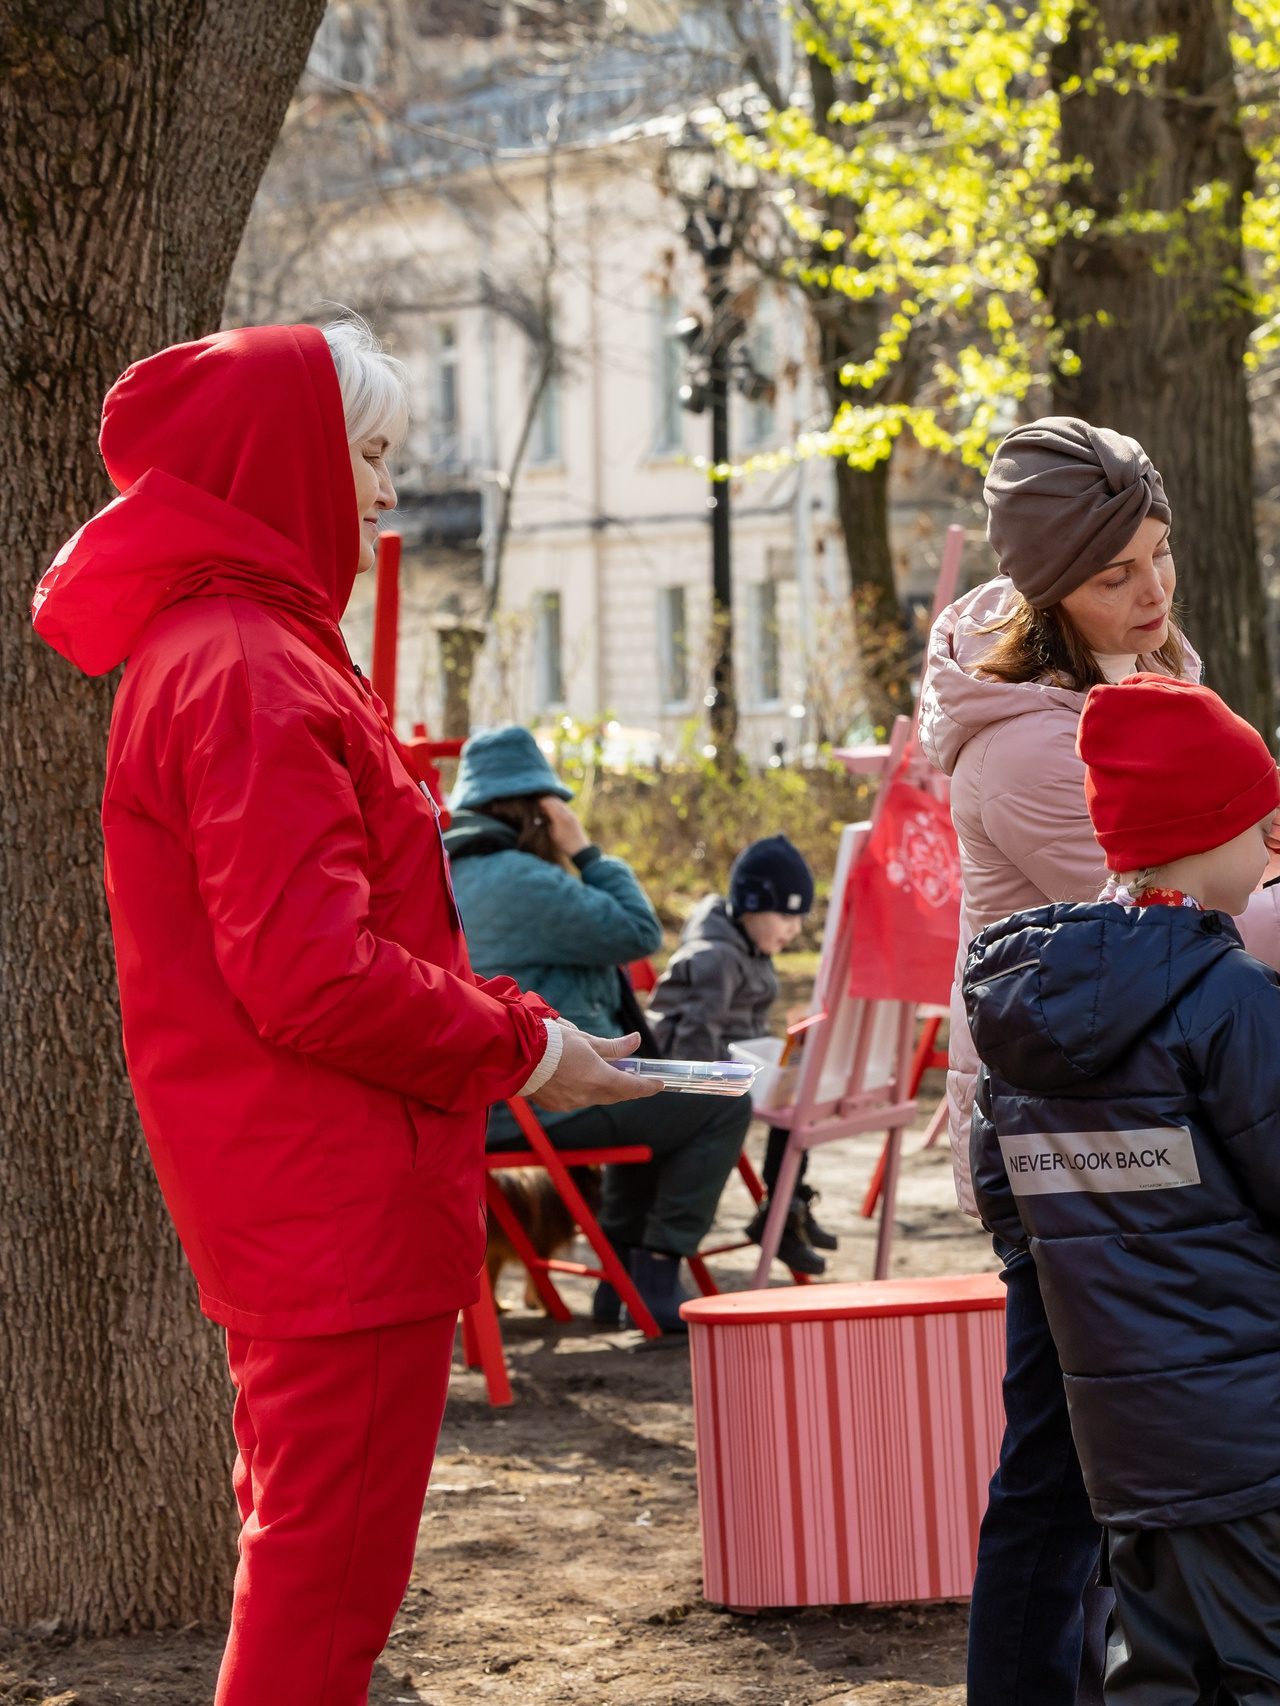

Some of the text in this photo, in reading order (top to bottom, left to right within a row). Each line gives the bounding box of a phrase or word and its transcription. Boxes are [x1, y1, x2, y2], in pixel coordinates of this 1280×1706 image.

[1009, 1148, 1171, 1172] NEVER LOOK BACK
